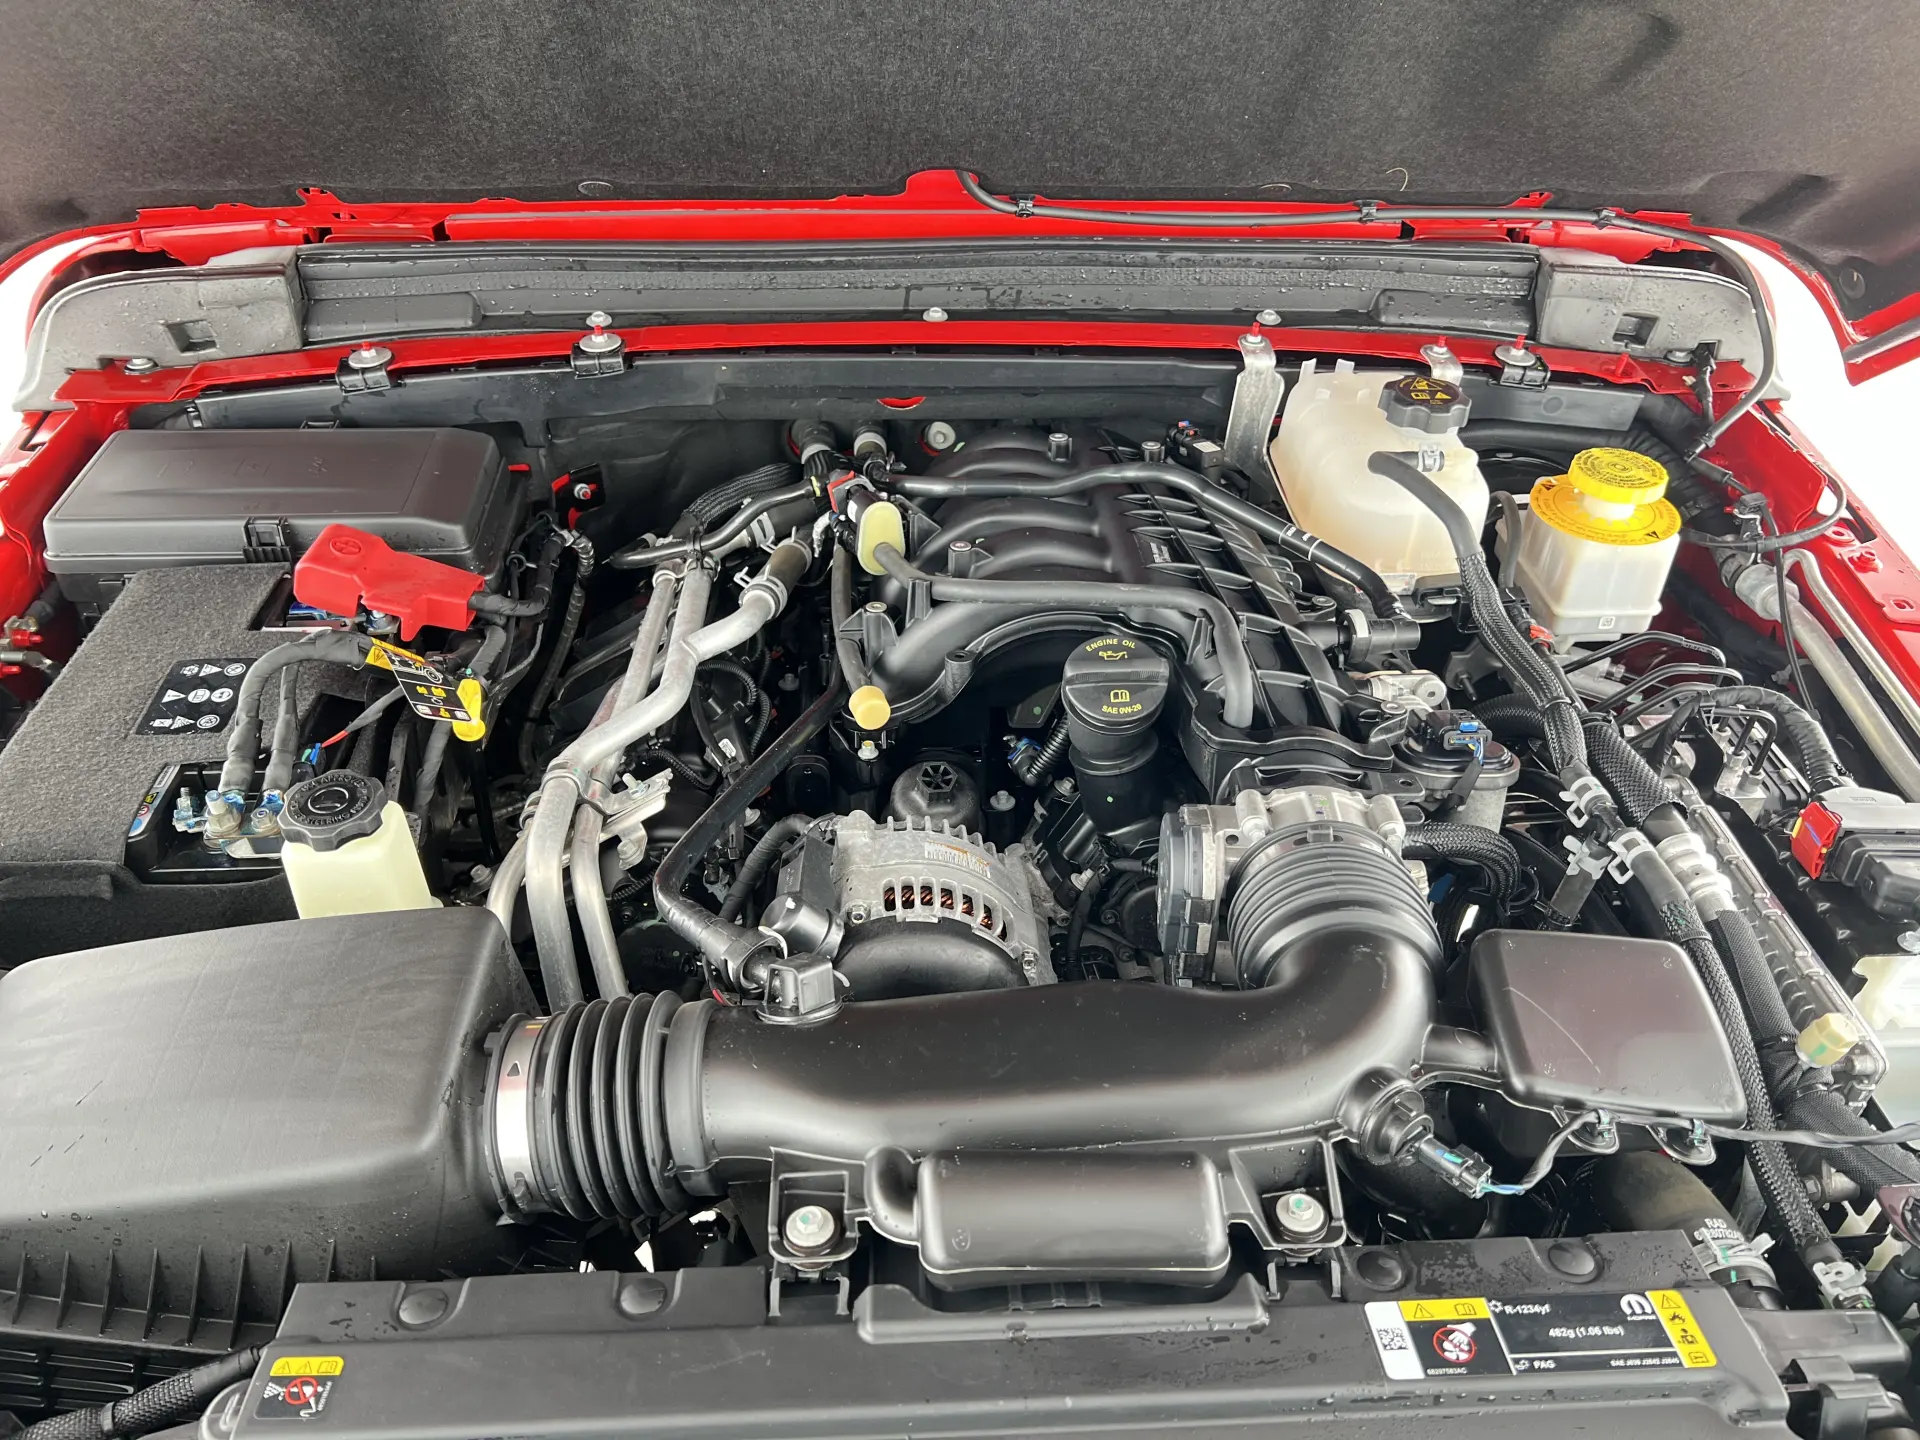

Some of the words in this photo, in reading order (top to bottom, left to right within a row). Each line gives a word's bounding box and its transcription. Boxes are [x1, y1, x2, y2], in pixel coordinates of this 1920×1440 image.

[1085, 639, 1118, 652] ENGINE
[1122, 640, 1136, 649] OIL
[1101, 705, 1118, 714] SAE
[1119, 703, 1142, 714] 0W-20
[1704, 1218, 1727, 1229] RAD
[1504, 1304, 1551, 1315] R-1234yf
[1549, 1327, 1575, 1338] 482g
[1576, 1326, 1602, 1337] (1.06
[1603, 1325, 1625, 1336] lbs)
[1533, 1360, 1557, 1369] PAG
